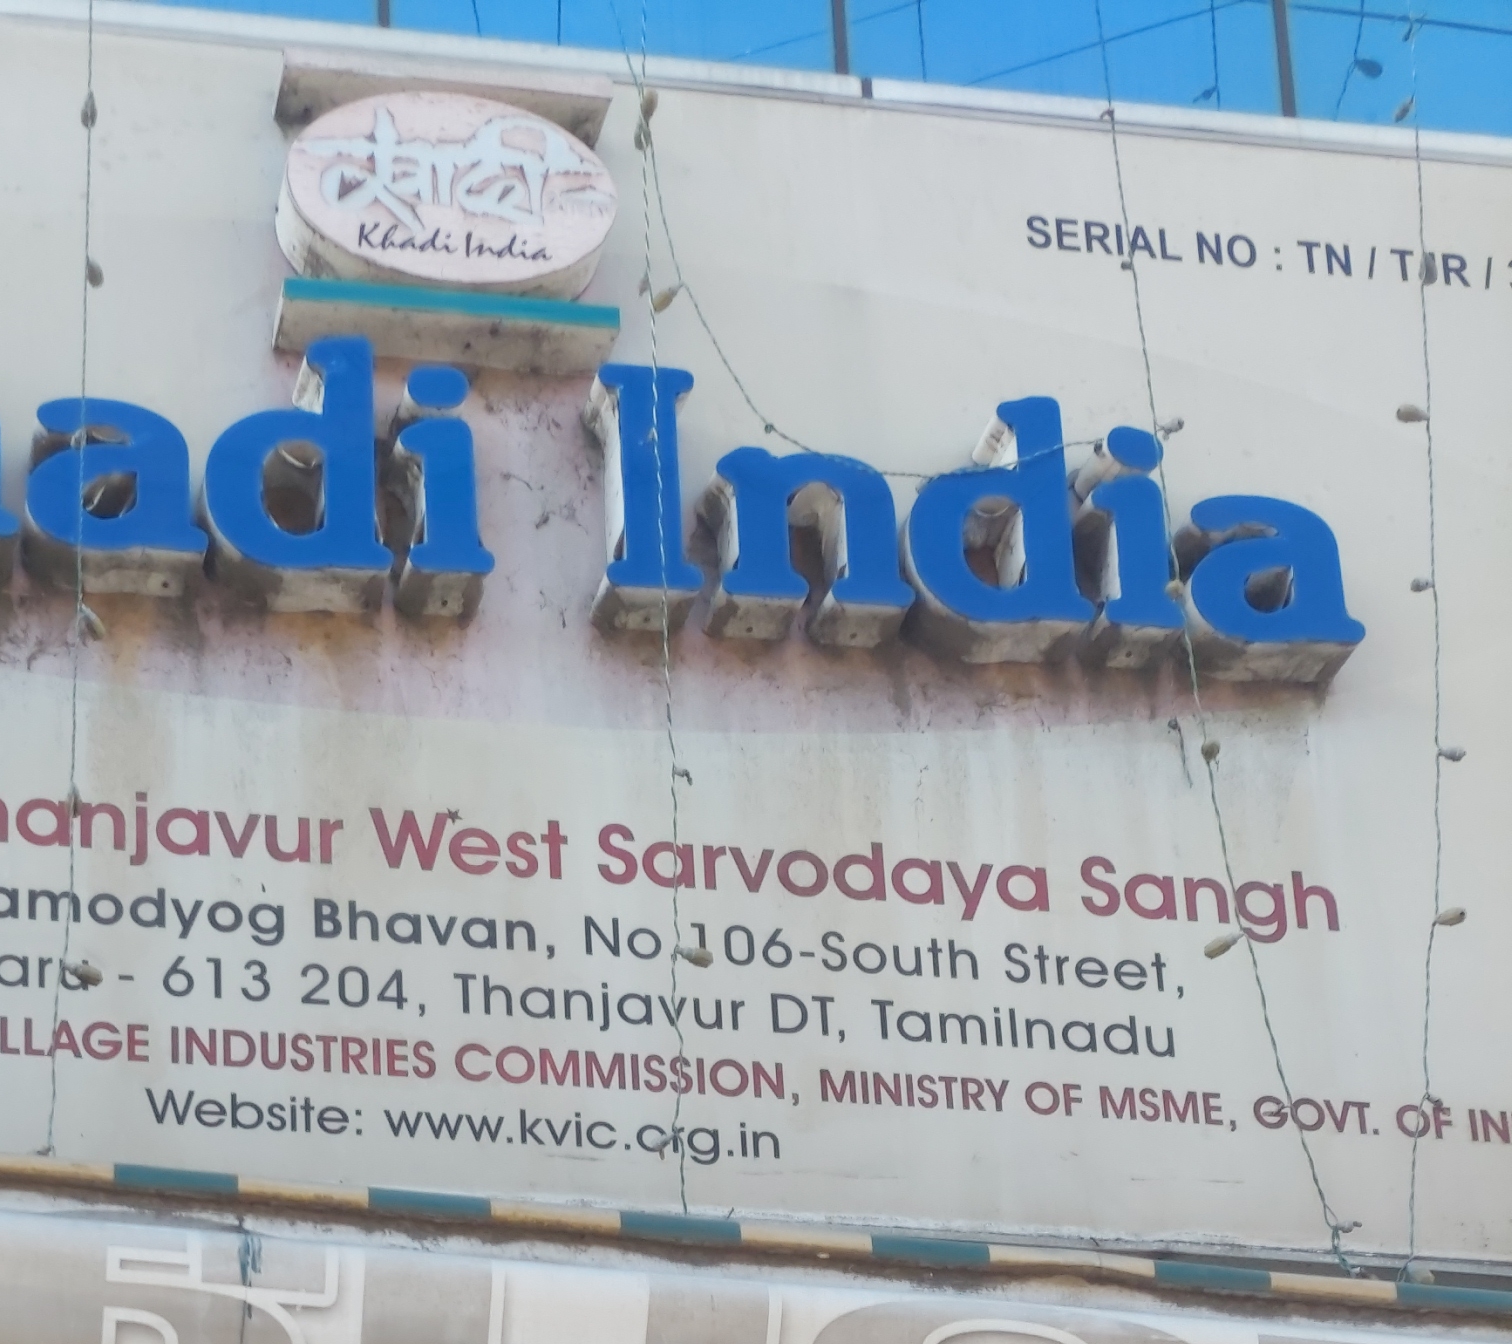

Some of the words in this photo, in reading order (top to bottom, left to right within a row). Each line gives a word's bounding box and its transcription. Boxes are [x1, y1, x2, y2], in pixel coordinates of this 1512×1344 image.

[357, 222, 459, 256] Khadi
[465, 230, 553, 262] India
[1025, 214, 1183, 262] SERIAL
[1196, 229, 1258, 269] NO
[1297, 239, 1353, 278] TN
[1390, 247, 1471, 288] TR
[592, 362, 1366, 646] India
[368, 806, 569, 880] West
[596, 822, 1050, 922] Sarvodaya
[1079, 854, 1341, 944] Sangh
[313, 897, 557, 961] Bhavan,
[583, 914, 662, 960] No
[688, 921, 979, 982] 106-South
[1004, 942, 1186, 998] Street,
[162, 955, 271, 1002] 613
[299, 962, 427, 1018] 204,
[453, 971, 745, 1036] Thanjavur
[769, 990, 847, 1044] DT,
[870, 998, 1176, 1059] Tamilnadu
[145, 1086, 364, 1139] Website:
[383, 1107, 782, 1166] www.kvic.org.in
[170, 1025, 436, 1081] INDUSTRIES
[454, 1041, 800, 1107] COMMISSION,
[819, 1068, 1009, 1115] MINISTRY
[1024, 1080, 1083, 1118] OF
[1099, 1085, 1239, 1132] MSME,
[1253, 1093, 1380, 1137] GOVT.
[1395, 1103, 1452, 1140] OF
[1468, 1108, 1512, 1145] IN
